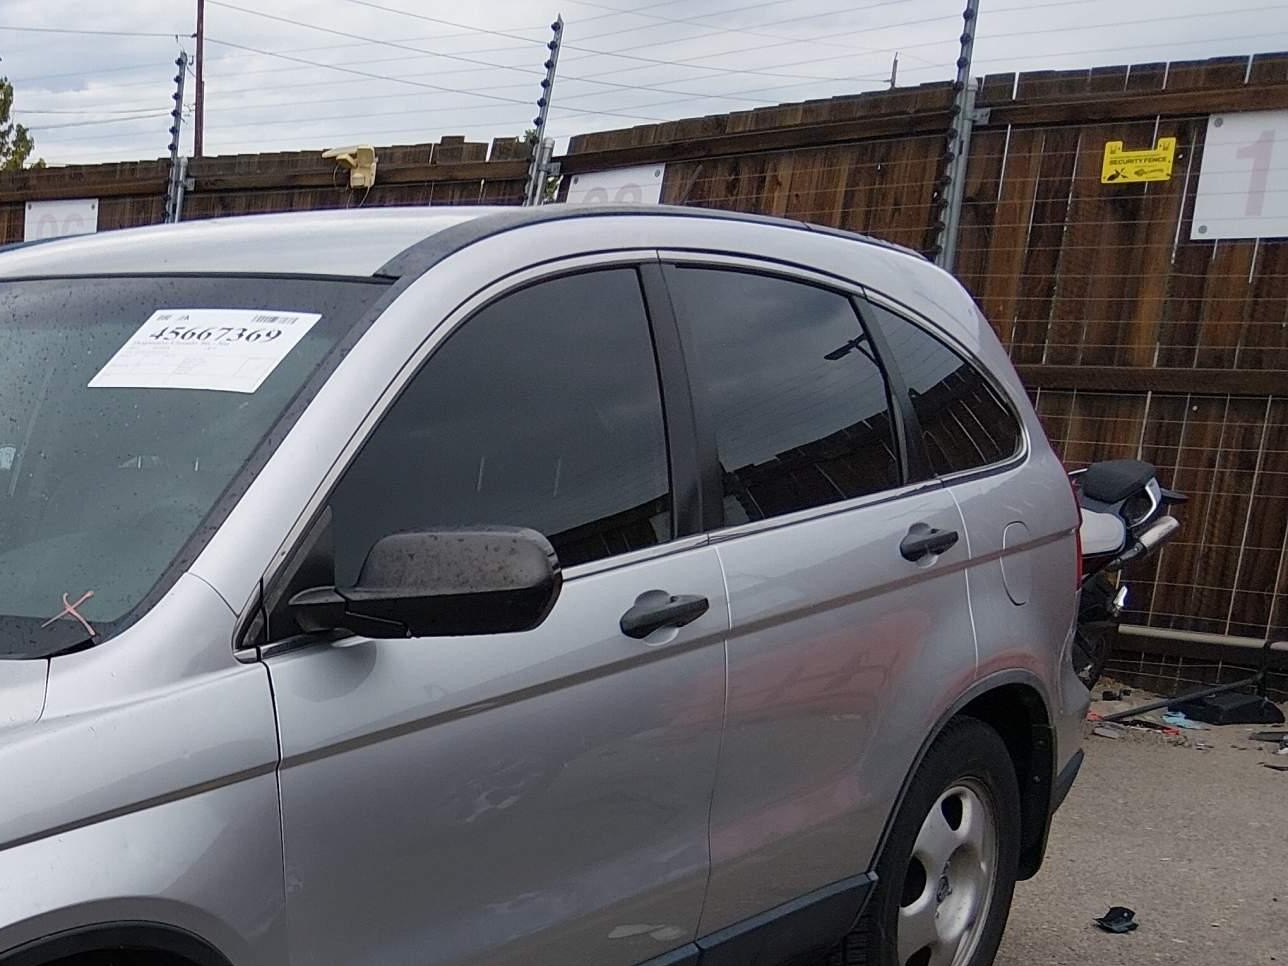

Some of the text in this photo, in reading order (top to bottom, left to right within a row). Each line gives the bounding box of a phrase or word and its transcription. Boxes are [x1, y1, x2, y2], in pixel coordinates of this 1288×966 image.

[1109, 157, 1143, 166] SECURITY
[1143, 156, 1167, 164] FENCE
[149, 326, 283, 343] 45667369
